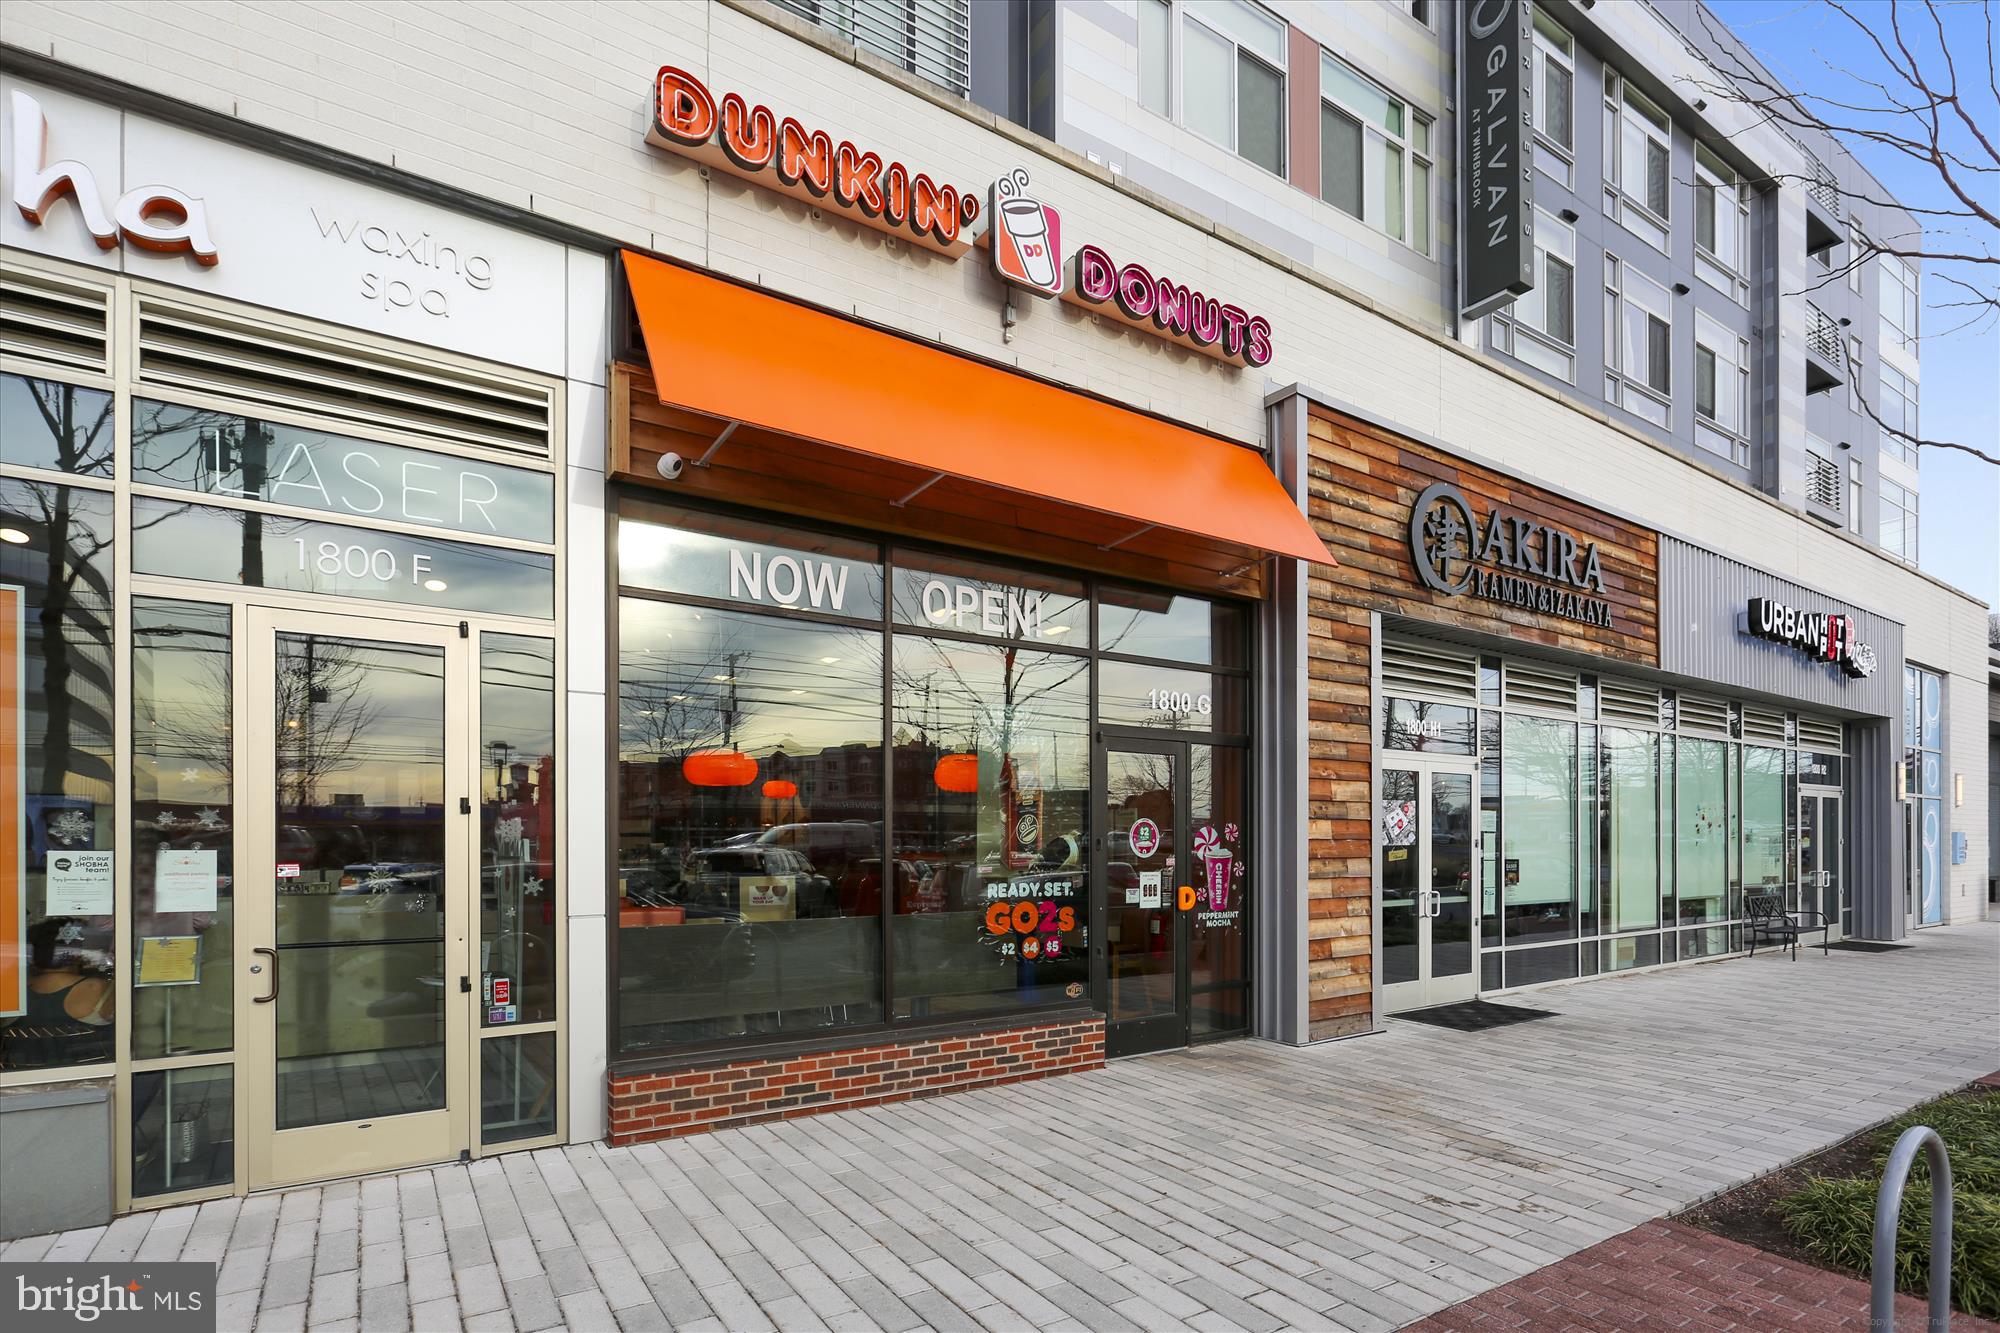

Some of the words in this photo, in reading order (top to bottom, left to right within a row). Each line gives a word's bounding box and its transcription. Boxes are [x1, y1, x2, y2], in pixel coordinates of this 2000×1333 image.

[1472, 108, 1481, 123] AT
[654, 65, 980, 246] DUNKIN'
[1472, 127, 1481, 208] TWINBROOK
[1487, 44, 1508, 247] GALVAN
[11, 88, 219, 266] ha
[311, 206, 493, 290] waxing
[1023, 244, 1043, 258] DD
[361, 272, 449, 318] spa
[1075, 244, 1272, 368] DONUTS
[216, 429, 498, 531] LASER
[294, 538, 396, 581] 1800
[412, 554, 431, 585] F
[1479, 509, 1607, 594] AKIRA
[729, 549, 849, 611] NOW
[922, 580, 1043, 639] OPEN!
[1760, 597, 1819, 647] URBAN
[1148, 688, 1191, 713] 1800
[1198, 694, 1212, 715] G
[1406, 719, 1427, 736] 1800
[1430, 720, 1441, 737] H1
[987, 882, 1043, 899] READY.
[1044, 881, 1074, 897] SET.
[1001, 943, 1016, 955] $2
[1023, 941, 1039, 953] $4
[1046, 940, 1059, 952] $5
[1206, 919, 1232, 928] MOCHA
